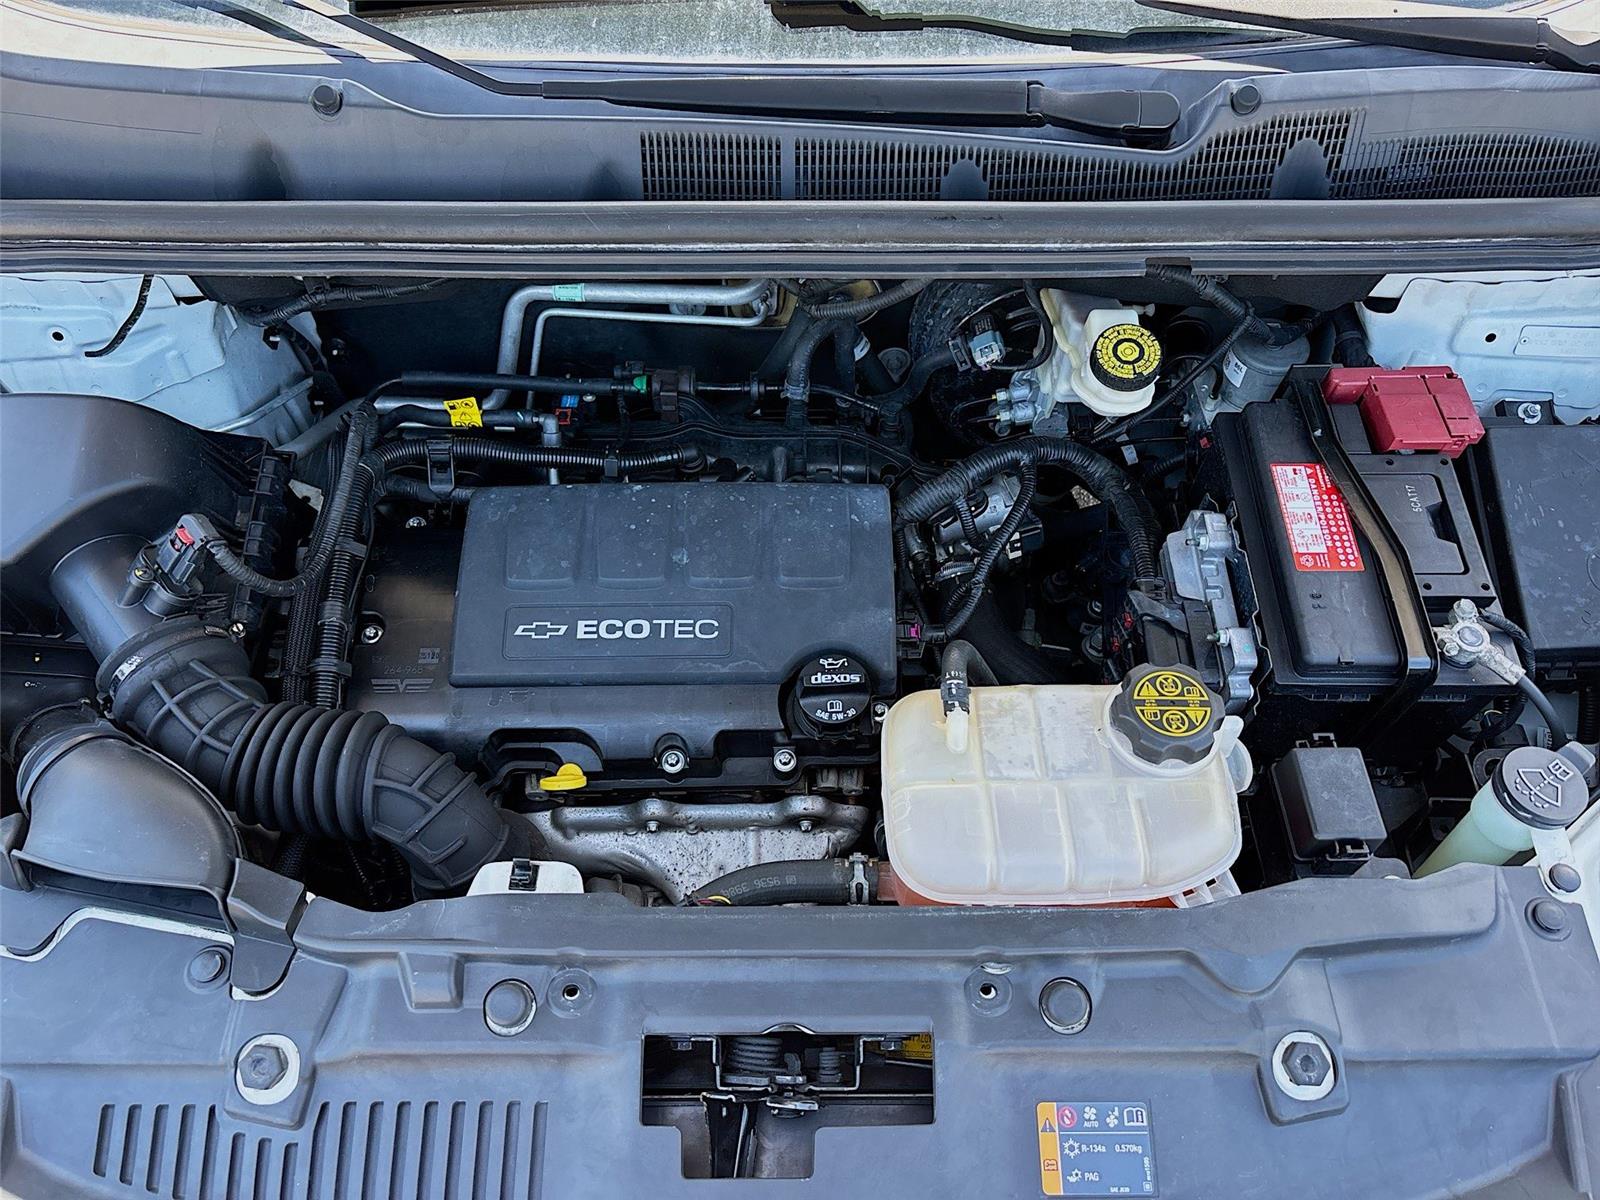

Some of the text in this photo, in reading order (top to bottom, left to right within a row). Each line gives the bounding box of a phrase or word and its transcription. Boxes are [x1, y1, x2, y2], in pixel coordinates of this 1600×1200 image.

[1308, 478, 1333, 547] DANGER/POISON
[576, 618, 719, 640] ECOTEC
[810, 672, 862, 684] dexos
[815, 707, 857, 720] SAE 5W-30
[1083, 1120, 1099, 1128] AUTO
[1081, 1144, 1143, 1154] R-134a 0.570kg
[1084, 1172, 1099, 1181] PAG
